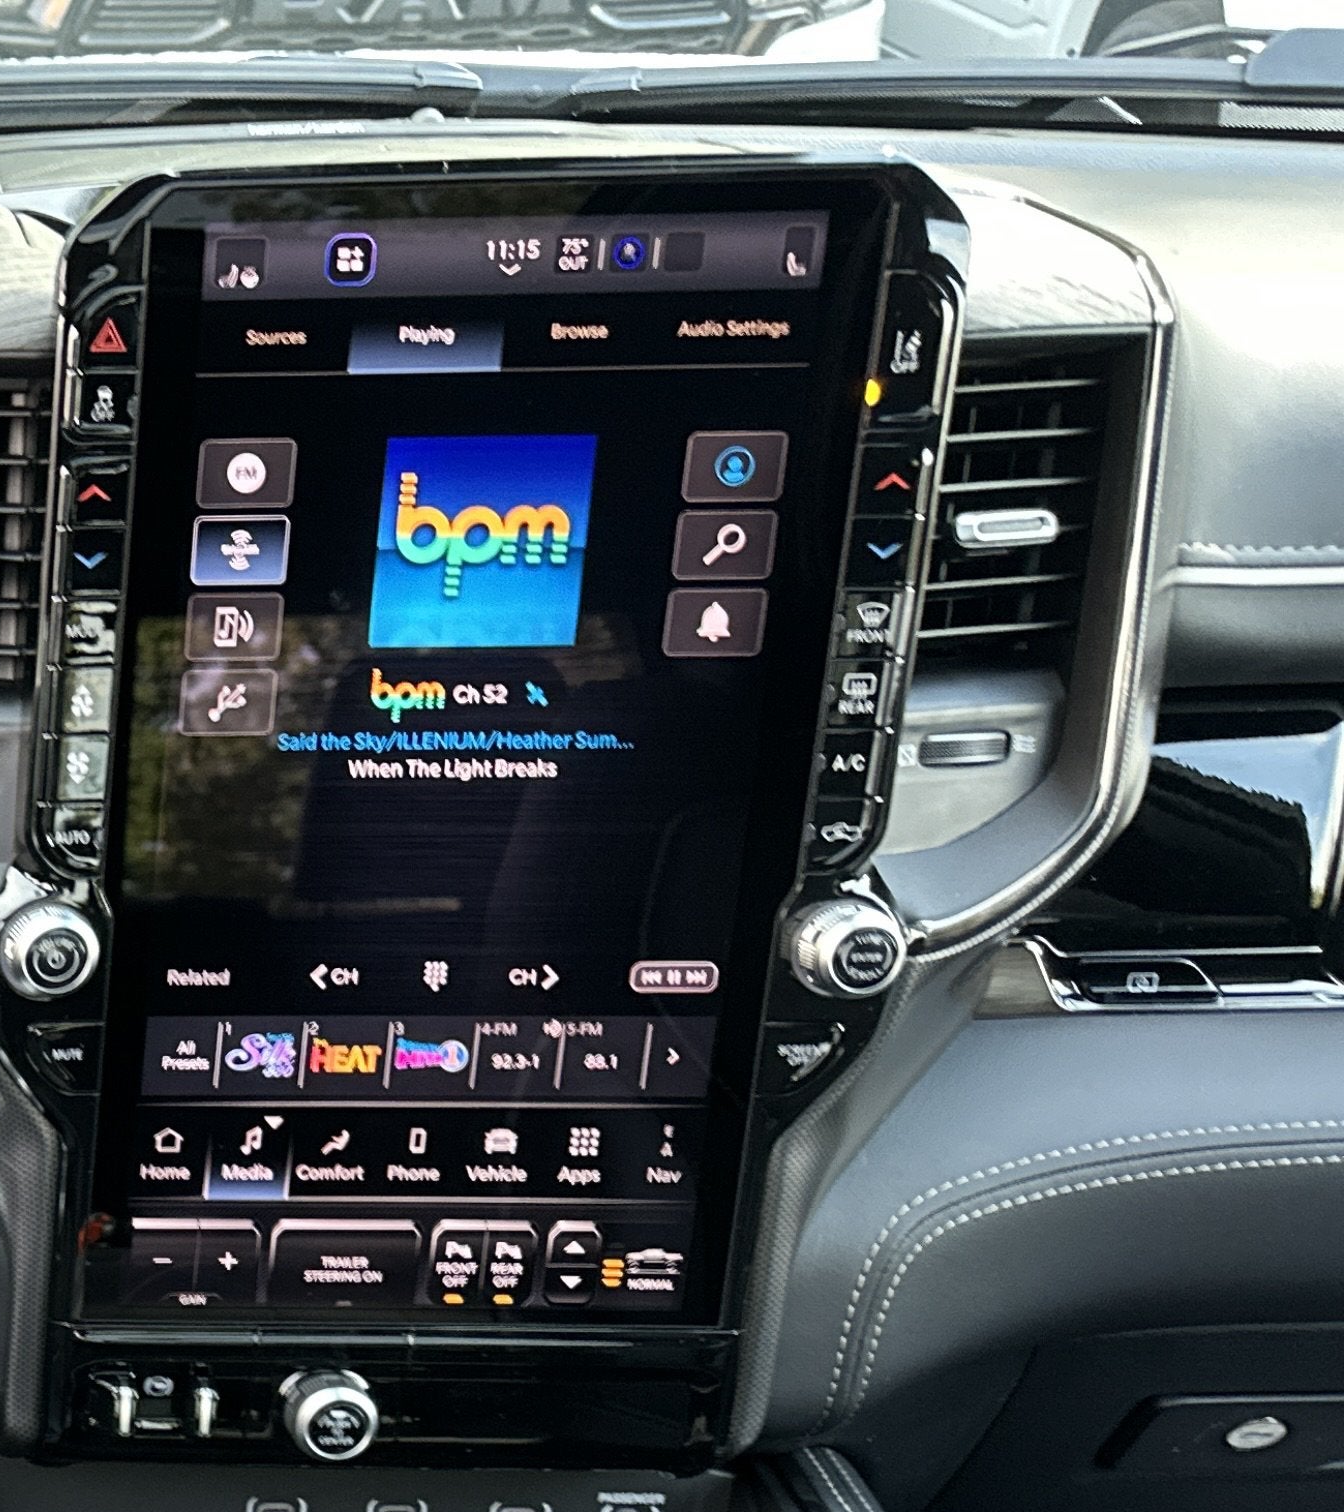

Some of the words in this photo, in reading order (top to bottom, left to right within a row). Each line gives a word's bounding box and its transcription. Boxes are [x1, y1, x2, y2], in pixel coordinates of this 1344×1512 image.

[487, 238, 541, 261] 11:15
[558, 255, 588, 271] OUT
[245, 329, 308, 346] Sources
[399, 325, 456, 346] Playing
[550, 322, 610, 340] Browse
[676, 320, 724, 338] Audio
[725, 318, 791, 339] Settings
[396, 471, 570, 597] bpm
[370, 667, 446, 723] bpm
[452, 683, 480, 705] Ch
[483, 683, 508, 705] 52
[277, 731, 319, 752] Said
[320, 731, 352, 751] the
[353, 730, 573, 754] Sky/ILLENIUM/Heather
[575, 730, 635, 750] Sum...
[348, 759, 403, 779] When
[407, 758, 443, 778] The
[444, 758, 492, 782] Light
[494, 758, 558, 778] Breaks
[831, 753, 866, 772] A/C
[167, 968, 231, 986] Related
[330, 968, 359, 986] CH
[508, 968, 537, 986] CH
[176, 1040, 197, 1056] All
[162, 1055, 210, 1071] Presets
[310, 1045, 382, 1073] HEAT
[140, 1164, 191, 1181] Home
[221, 1163, 274, 1181] Media
[295, 1163, 365, 1181] Comfort
[387, 1164, 440, 1182] Phone
[465, 1165, 528, 1183] Vehicle
[557, 1165, 601, 1186] Apps
[646, 1166, 682, 1183] Nav
[320, 1256, 369, 1269] TRAILER
[435, 1262, 478, 1275] FRONT
[490, 1262, 523, 1275] REAR
[303, 1270, 361, 1283] STEERING
[362, 1271, 383, 1283] ON
[442, 1275, 468, 1288] OFF
[492, 1275, 519, 1288] OFF
[627, 1278, 675, 1291] NORMAL
